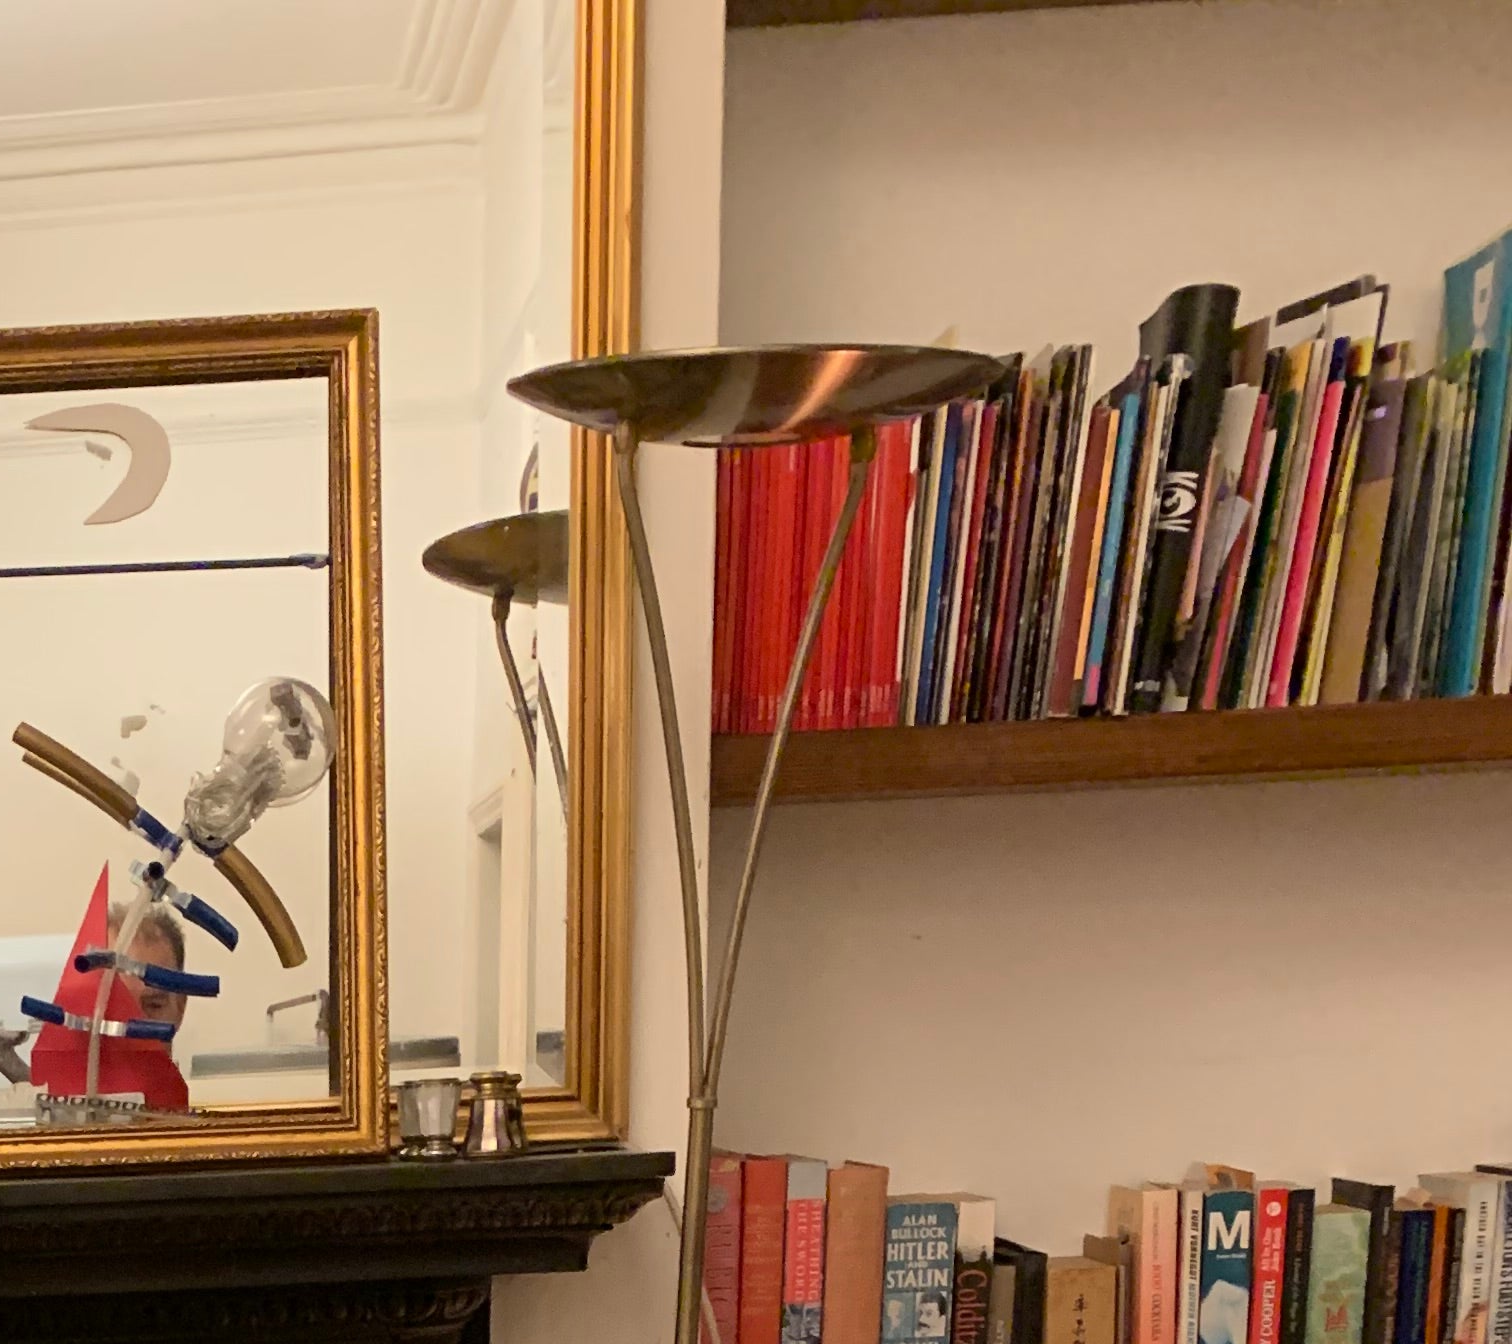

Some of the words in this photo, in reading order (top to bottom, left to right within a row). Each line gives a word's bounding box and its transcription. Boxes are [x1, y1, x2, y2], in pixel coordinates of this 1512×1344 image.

[797, 1202, 806, 1241] THE
[891, 1226, 947, 1240] BULLOCK
[902, 1214, 938, 1227] ALAN
[1191, 1209, 1200, 1232] KURT
[1207, 1210, 1250, 1250] M
[808, 1200, 821, 1300] SHEATHING
[888, 1240, 949, 1262] HITLER
[908, 1261, 928, 1269] AND
[1190, 1234, 1199, 1281] VONNEGUT
[795, 1243, 805, 1301] SWORD
[887, 1268, 949, 1289] STALIN
[1260, 1279, 1276, 1337] COOPER
